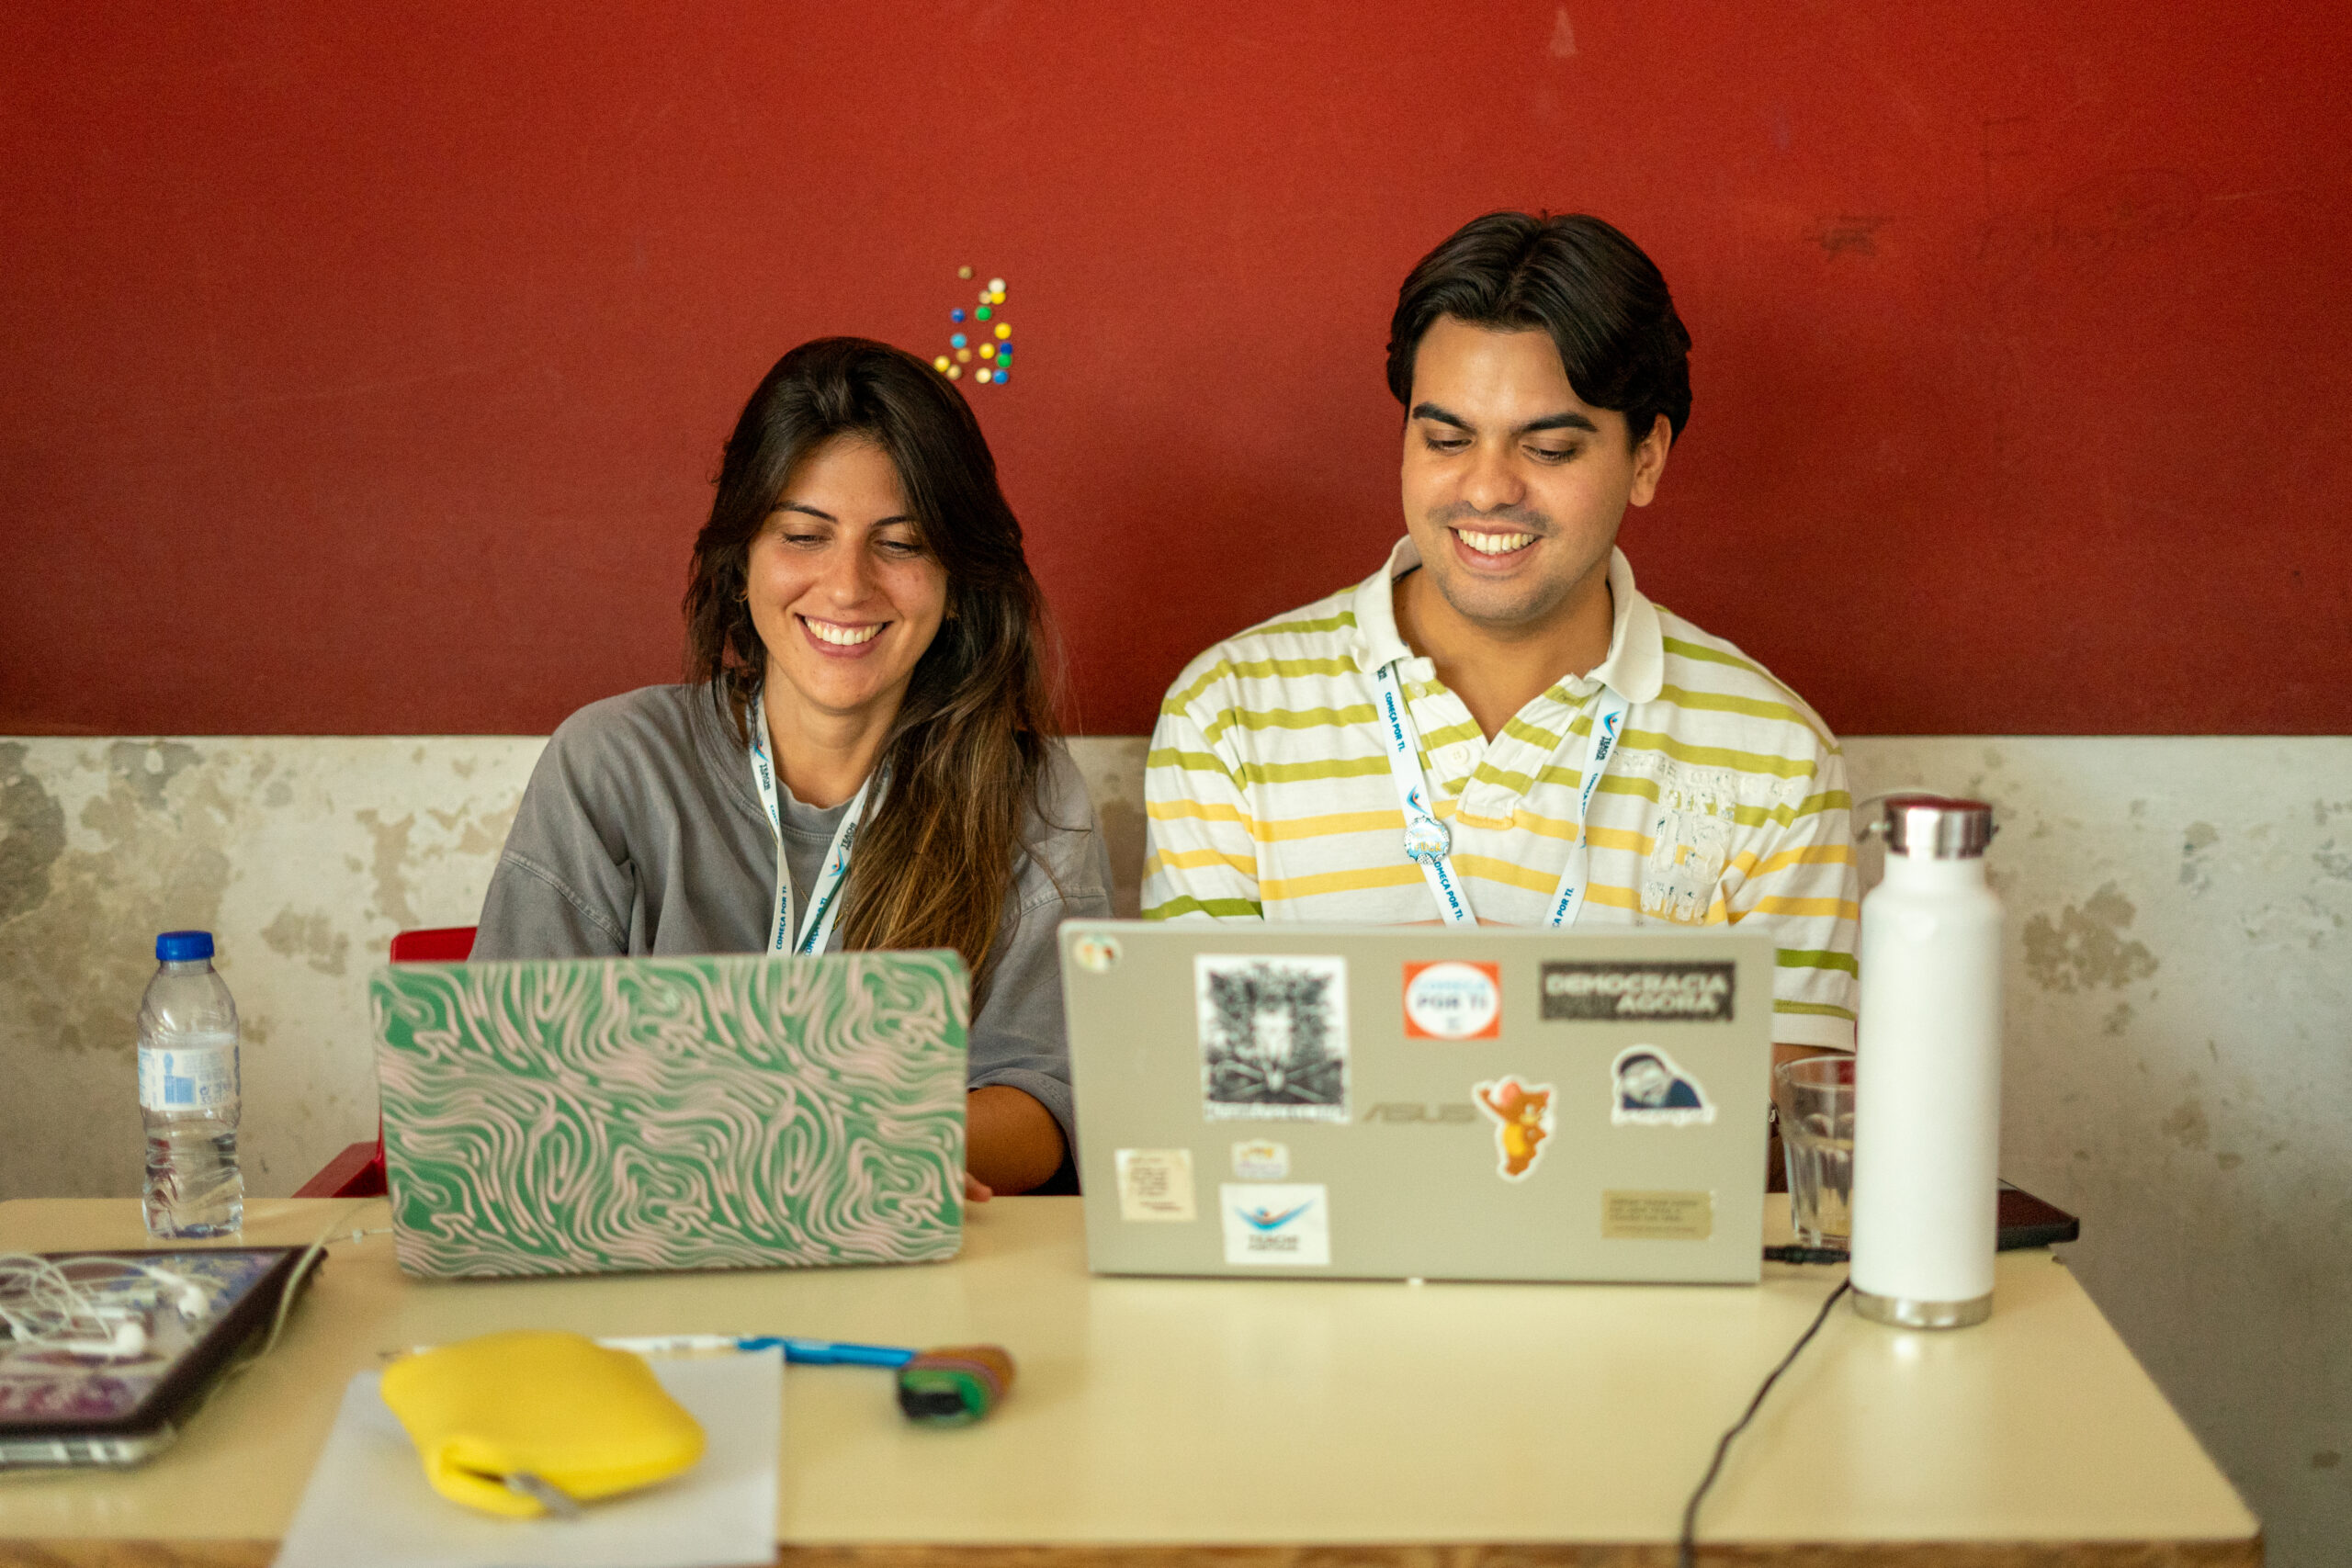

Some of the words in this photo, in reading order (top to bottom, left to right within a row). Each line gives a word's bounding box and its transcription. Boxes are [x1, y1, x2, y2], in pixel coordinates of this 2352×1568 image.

[1385, 691, 1397, 724] COMEÇA
[1392, 723, 1403, 741] POR
[1433, 861, 1452, 891] OMEÇA
[1445, 890, 1460, 909] POR
[1556, 898, 1570, 918] POR
[775, 916, 786, 951] COMEÇA
[1545, 974, 1727, 996] DEMOCRACIA
[1417, 994, 1461, 1010] POR
[1470, 994, 1487, 1010] TI
[1614, 993, 1718, 1012] AGORA
